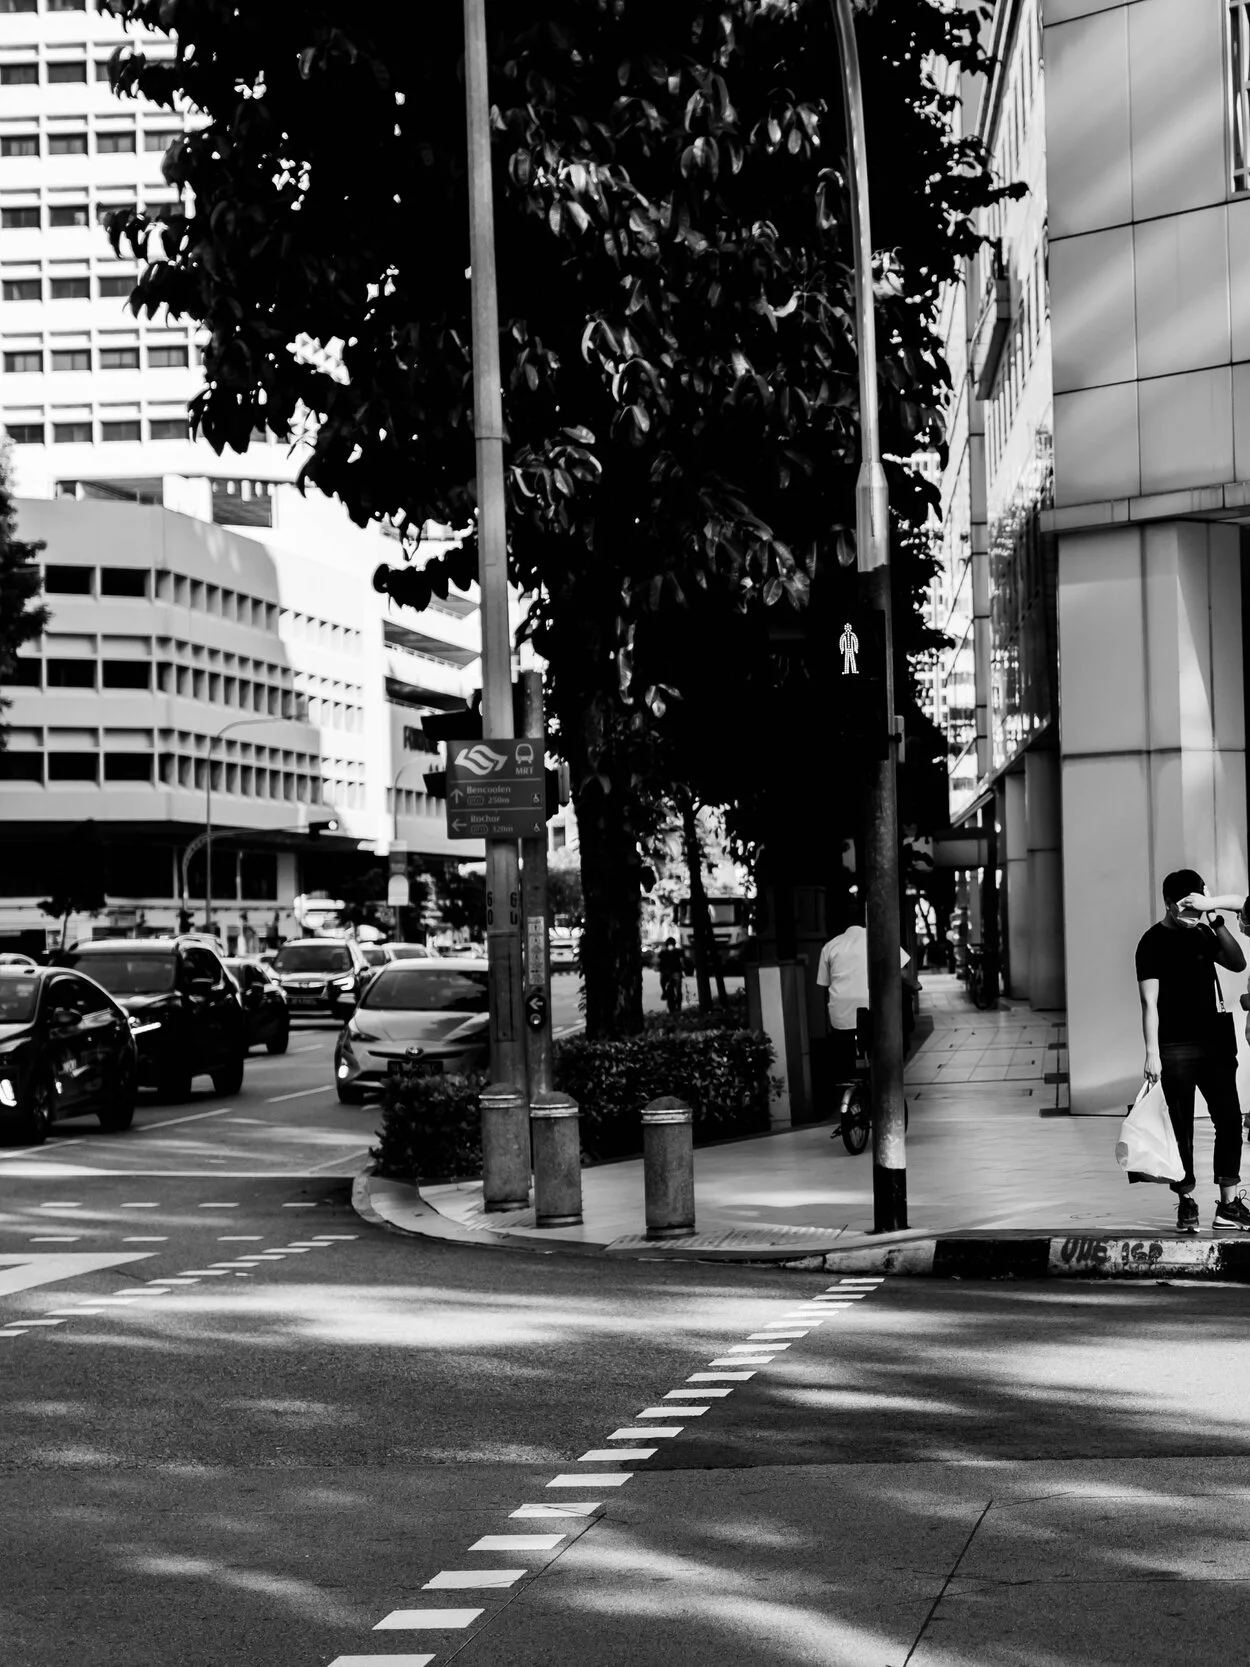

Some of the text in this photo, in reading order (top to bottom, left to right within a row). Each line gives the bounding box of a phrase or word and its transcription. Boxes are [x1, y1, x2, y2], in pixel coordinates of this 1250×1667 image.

[515, 767, 534, 775] MRT
[466, 785, 511, 794] Bencoolen
[470, 814, 500, 823] Rochor
